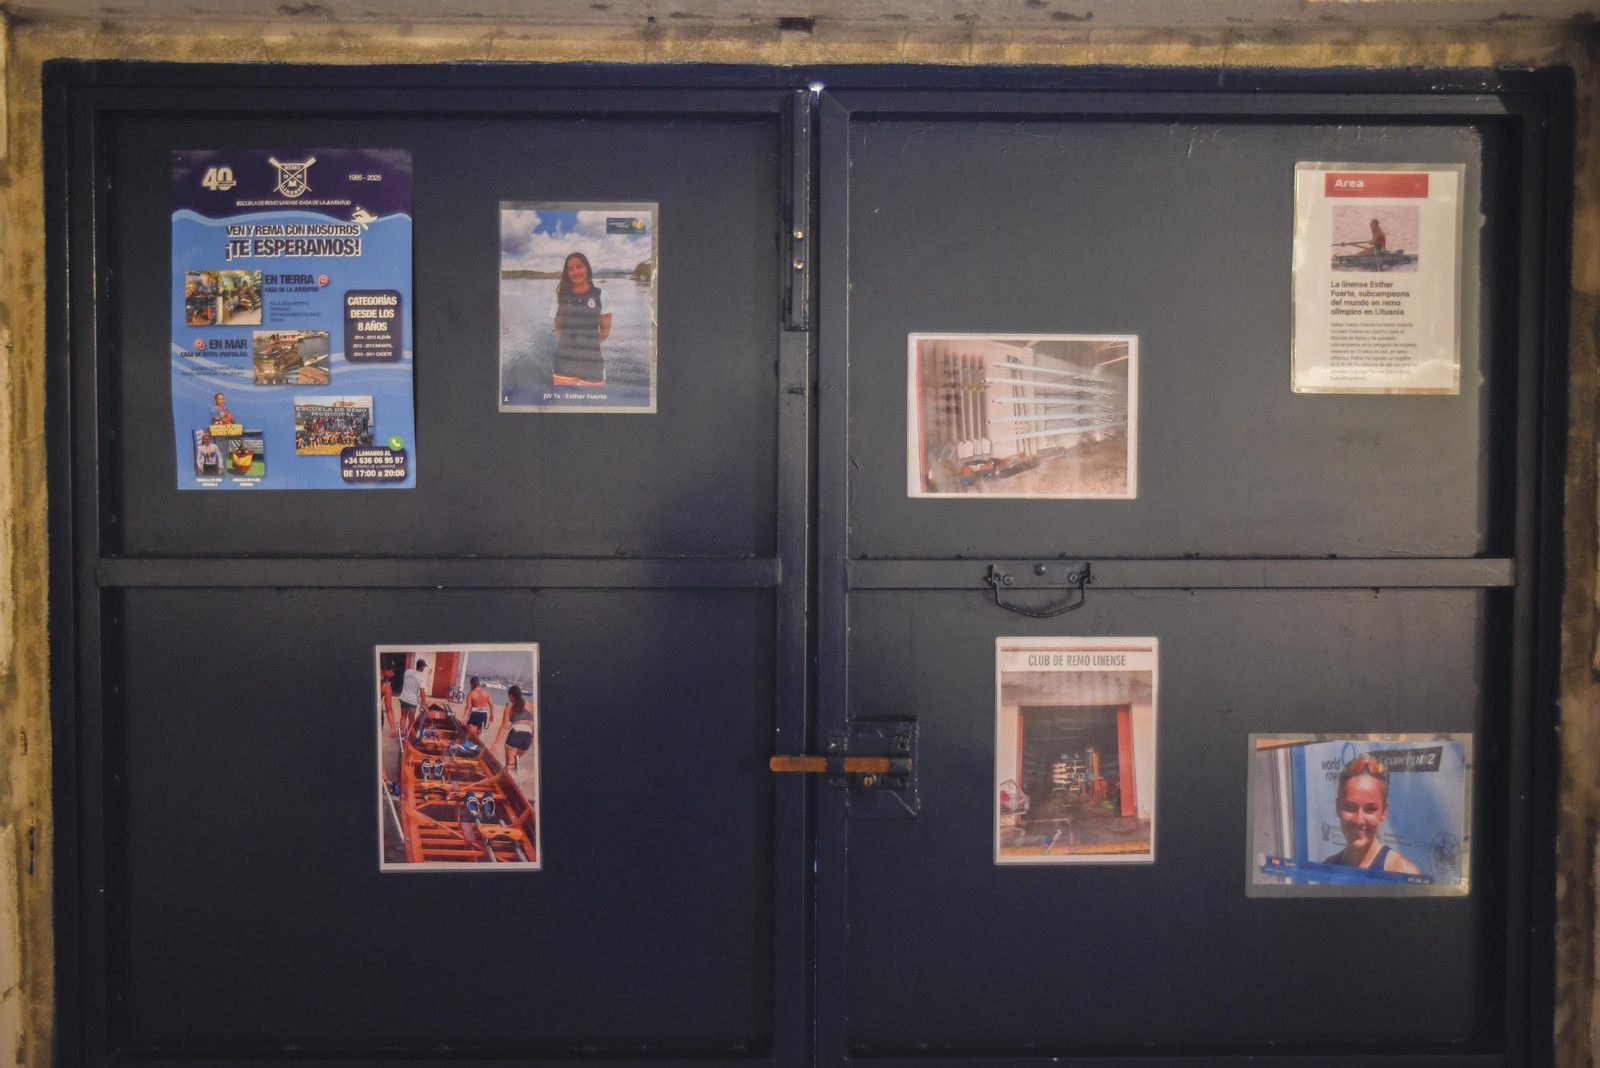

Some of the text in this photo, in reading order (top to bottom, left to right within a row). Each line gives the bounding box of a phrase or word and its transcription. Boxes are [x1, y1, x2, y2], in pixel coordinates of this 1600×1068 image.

[203, 168, 236, 190] 40
[1334, 179, 1364, 188] Area
[282, 184, 304, 195] LINENSE
[226, 225, 360, 237] VEN Y REMA CON NOSOTROS
[226, 239, 361, 261] ¡TE ESPERAMOS!
[265, 275, 314, 285] EN TIERRA
[1358, 290, 1410, 298] subcampeona
[348, 294, 397, 306] CATEGORÍAS
[350, 309, 395, 318] DESDE LOS
[1331, 308, 1362, 316] olímpico
[357, 320, 387, 331] 8 AÑOS
[209, 339, 247, 349] EN MAR
[1028, 655, 1125, 666] CLUB DE REMO LINENSE
[1321, 758, 1340, 770] world
[1384, 753, 1435, 767] concept 2
